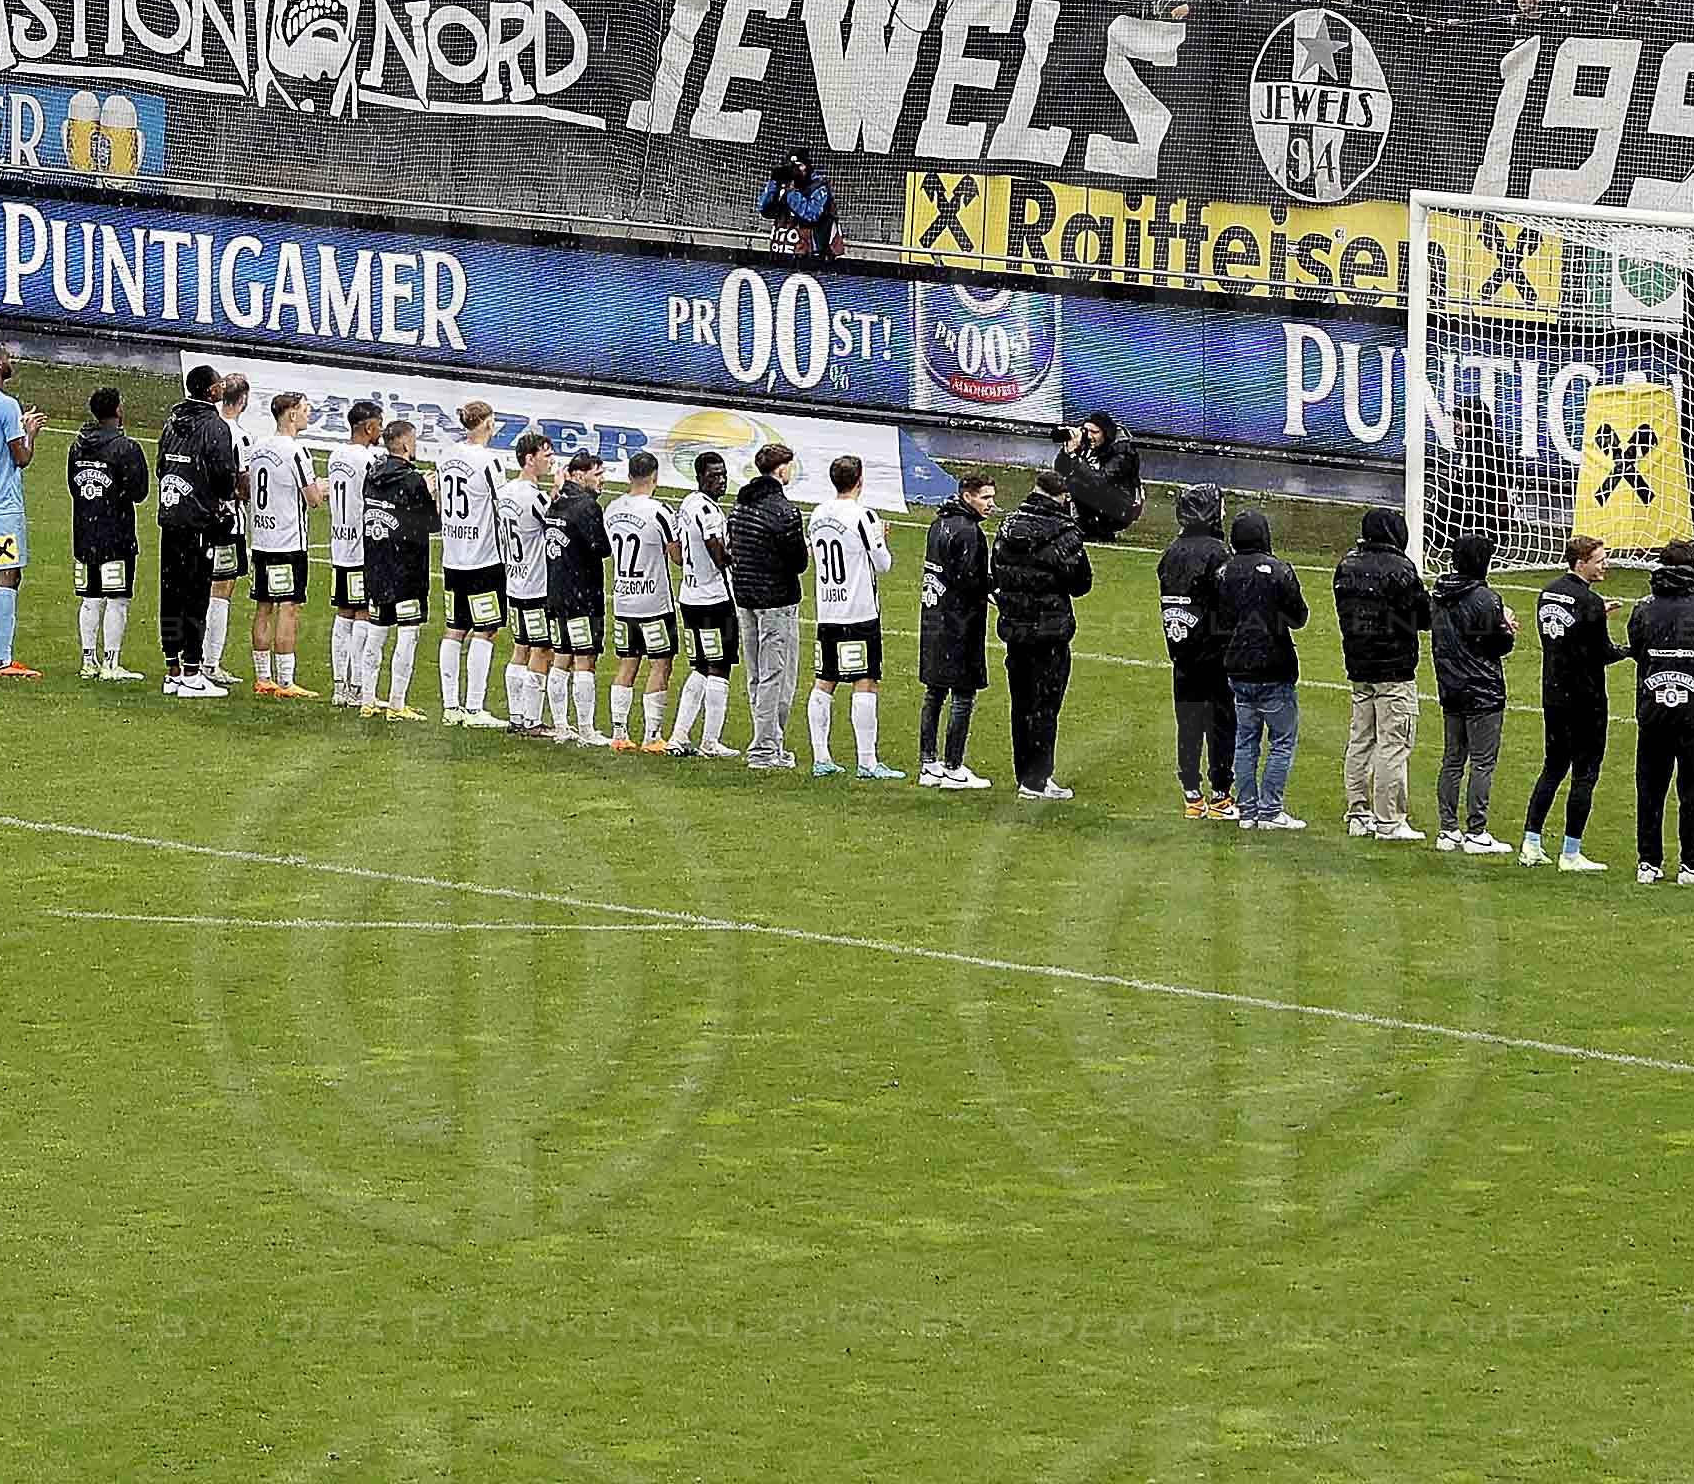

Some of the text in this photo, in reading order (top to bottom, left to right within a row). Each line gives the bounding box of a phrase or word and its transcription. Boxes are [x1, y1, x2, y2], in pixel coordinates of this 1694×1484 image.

[1258, 79, 1375, 130] JEWELS
[1286, 129, 1340, 186] 94
[1006, 176, 1447, 307] Raiffeisen
[0, 201, 470, 352] PUNTIGAMER
[256, 467, 269, 511] 8
[332, 479, 348, 525] 11
[443, 474, 469, 520] 35
[611, 532, 645, 578] 22
[816, 538, 847, 585] 30
